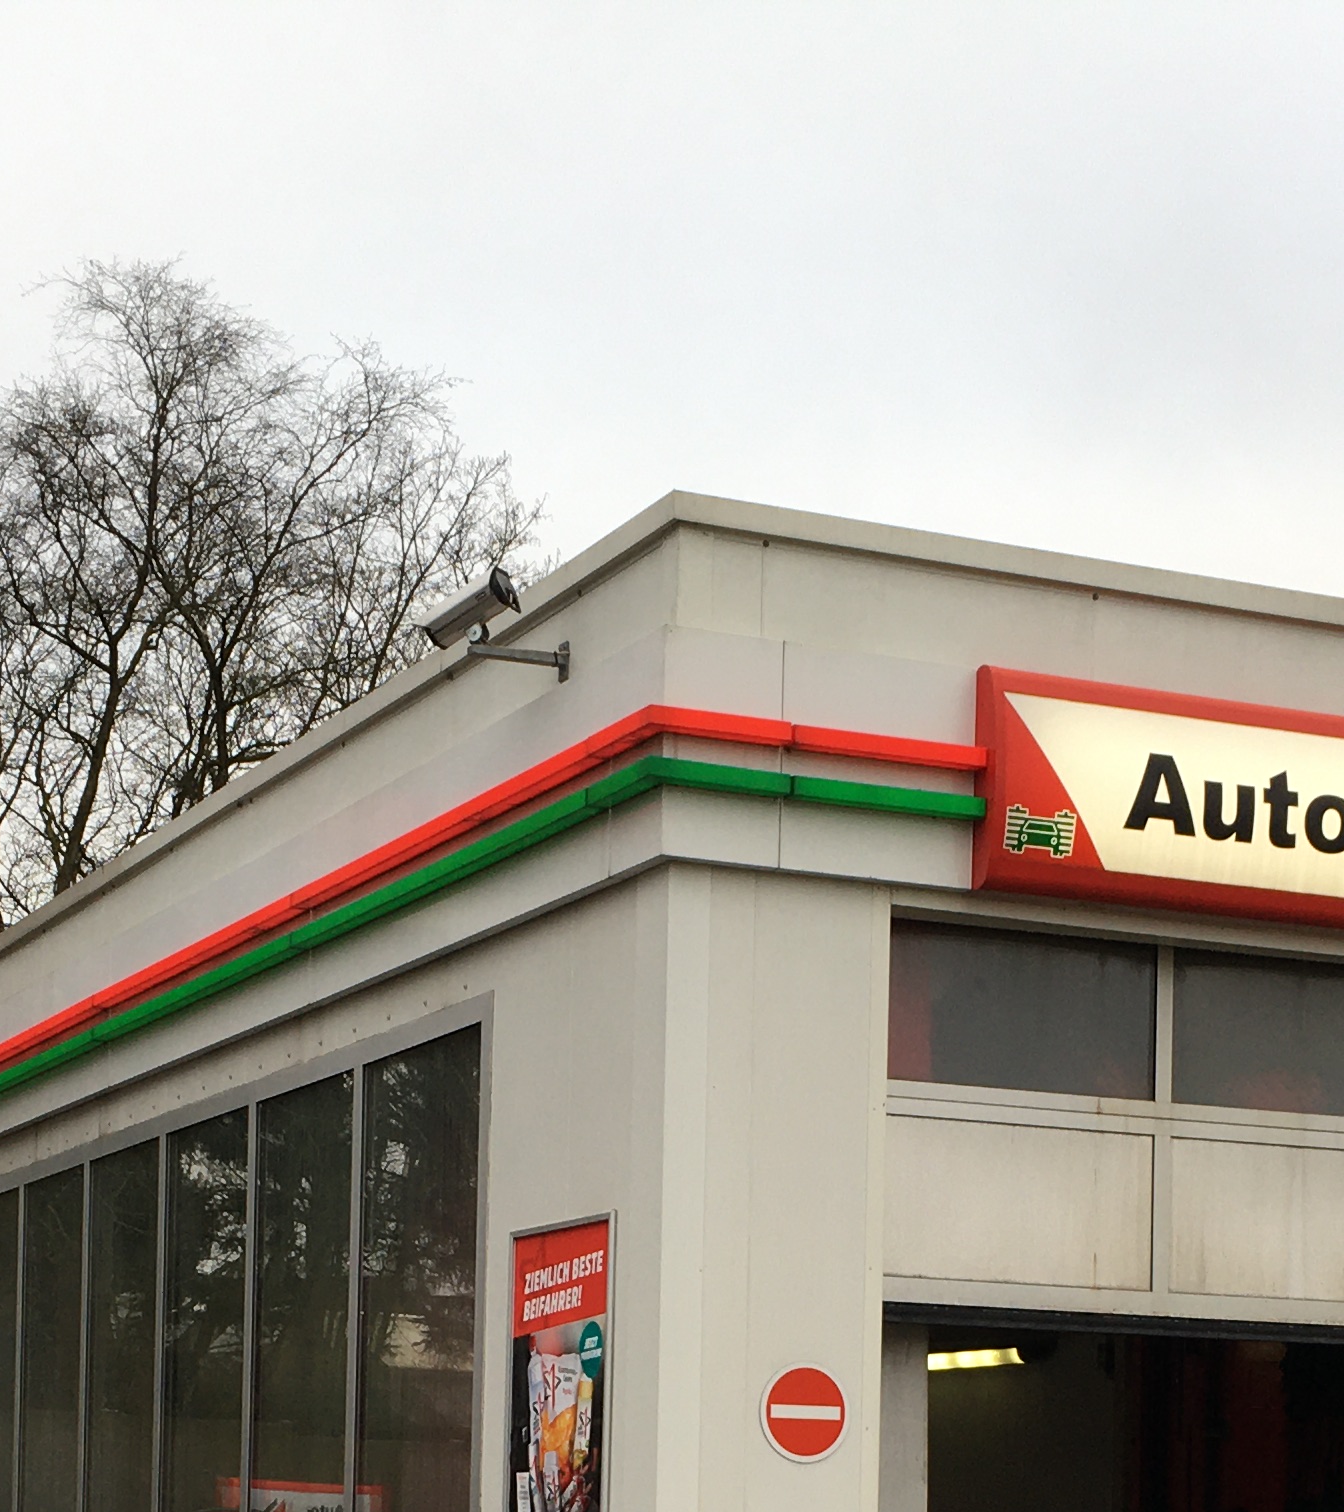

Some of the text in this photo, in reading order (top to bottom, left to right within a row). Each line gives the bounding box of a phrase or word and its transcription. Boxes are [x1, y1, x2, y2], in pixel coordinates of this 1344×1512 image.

[524, 1250, 604, 1294] ZIEMLICH BESTE
[522, 1285, 583, 1322] BEIFAHRER!
